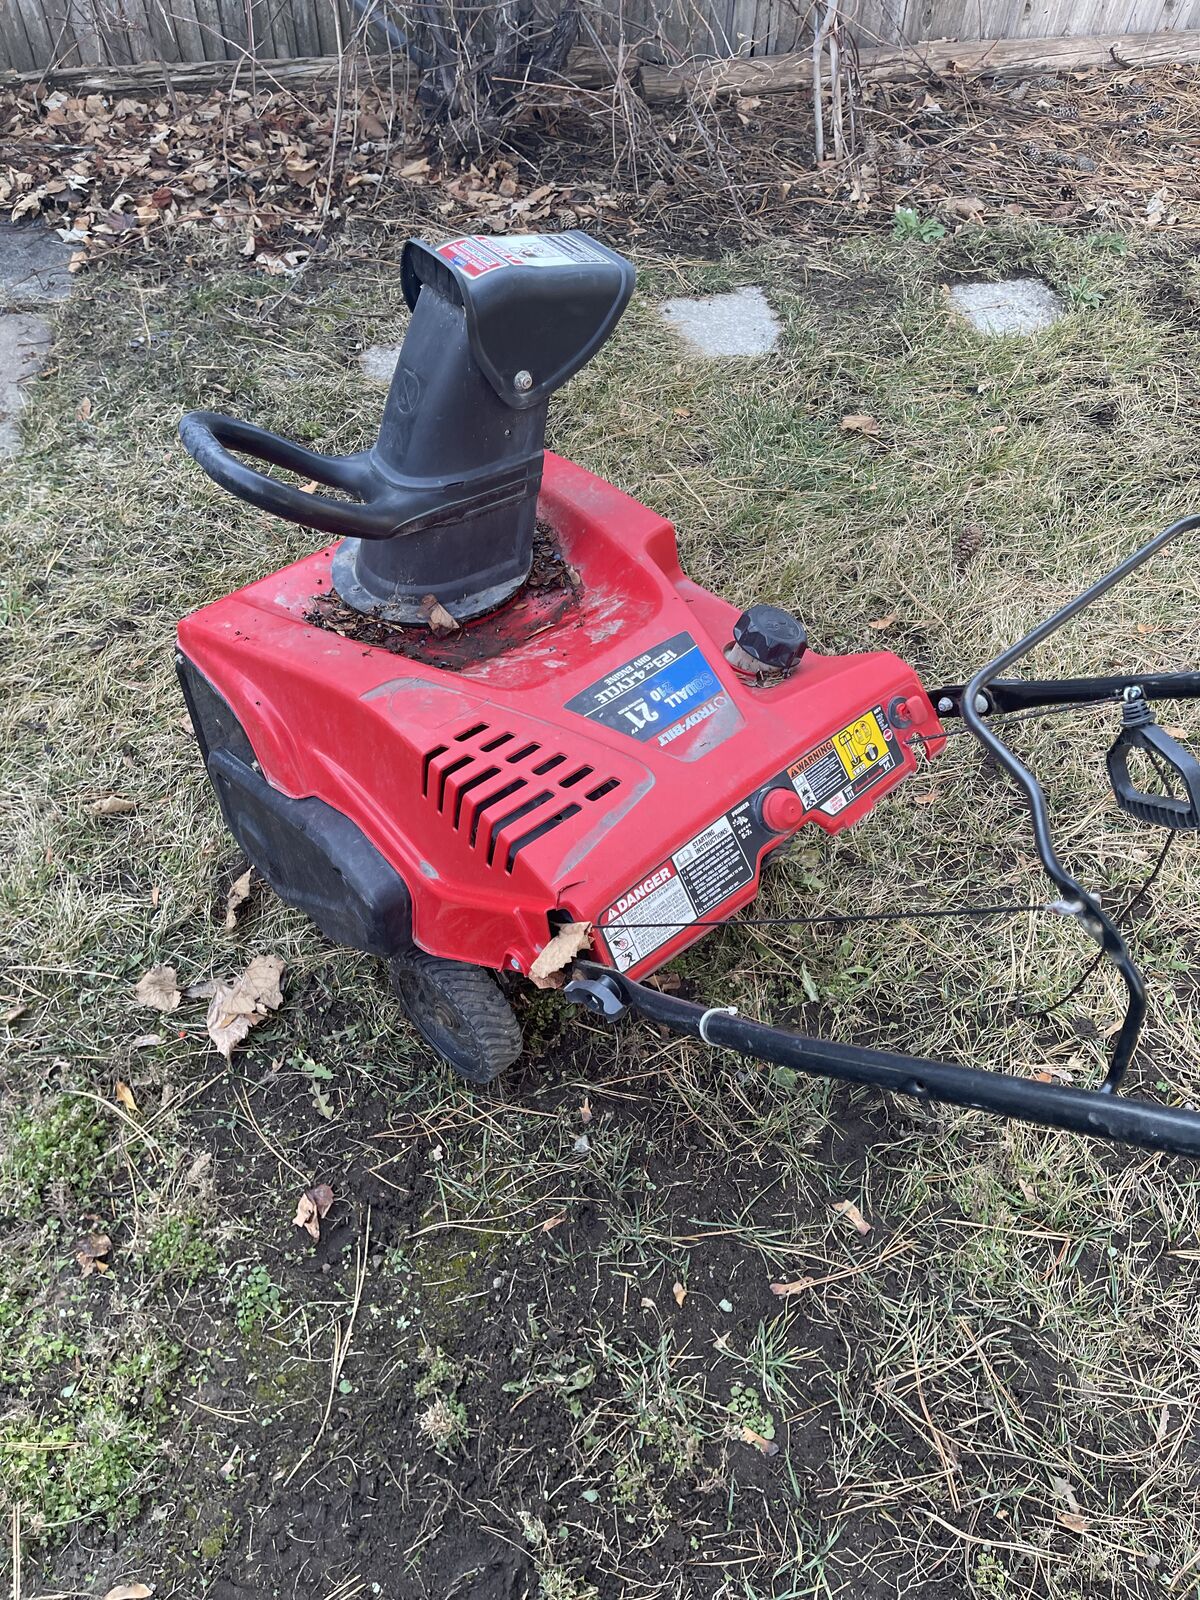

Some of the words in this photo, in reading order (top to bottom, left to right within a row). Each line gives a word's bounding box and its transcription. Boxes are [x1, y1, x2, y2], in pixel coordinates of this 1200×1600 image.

[604, 664, 635, 686] ENGINE
[633, 654, 652, 668] OHV
[594, 669, 646, 704] 4-CYCLE
[649, 681, 675, 702] 210
[664, 672, 714, 708] SQUALL
[657, 704, 719, 747] TROY-BILT
[796, 741, 833, 772] WARNING
[692, 829, 716, 849] STARTING
[694, 827, 729, 855] INSTRUCTIONS:
[616, 867, 672, 914] DANGER
